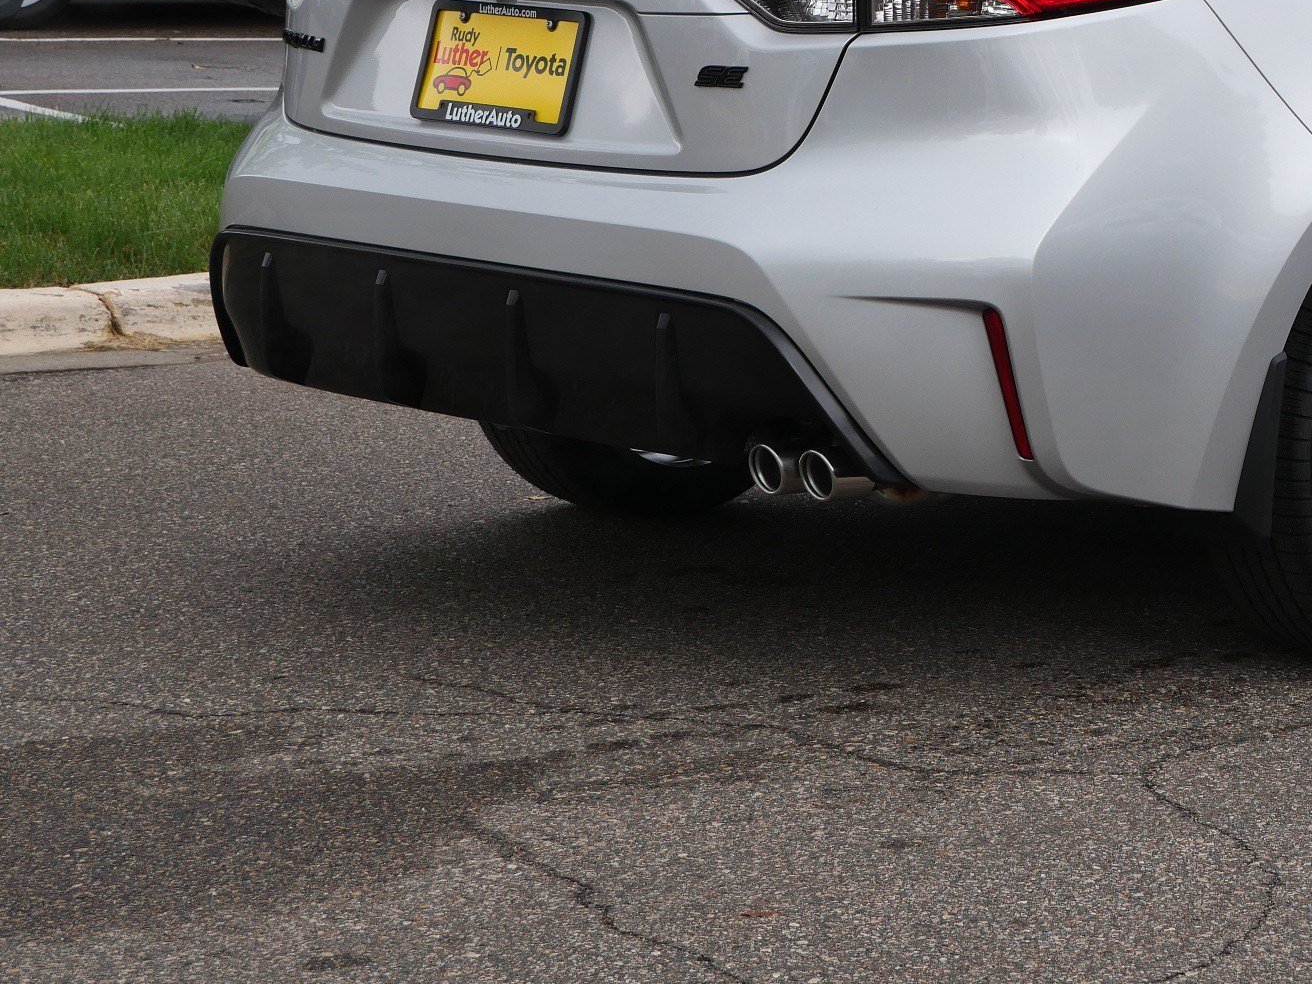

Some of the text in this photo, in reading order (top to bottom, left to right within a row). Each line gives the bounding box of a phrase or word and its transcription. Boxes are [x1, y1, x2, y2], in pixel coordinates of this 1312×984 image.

[479, 3, 537, 19] LutherAuto.com
[450, 26, 481, 46] Rudy
[433, 40, 490, 68] Luther
[505, 47, 568, 79] Toyota
[445, 102, 522, 128] LutherAuto
